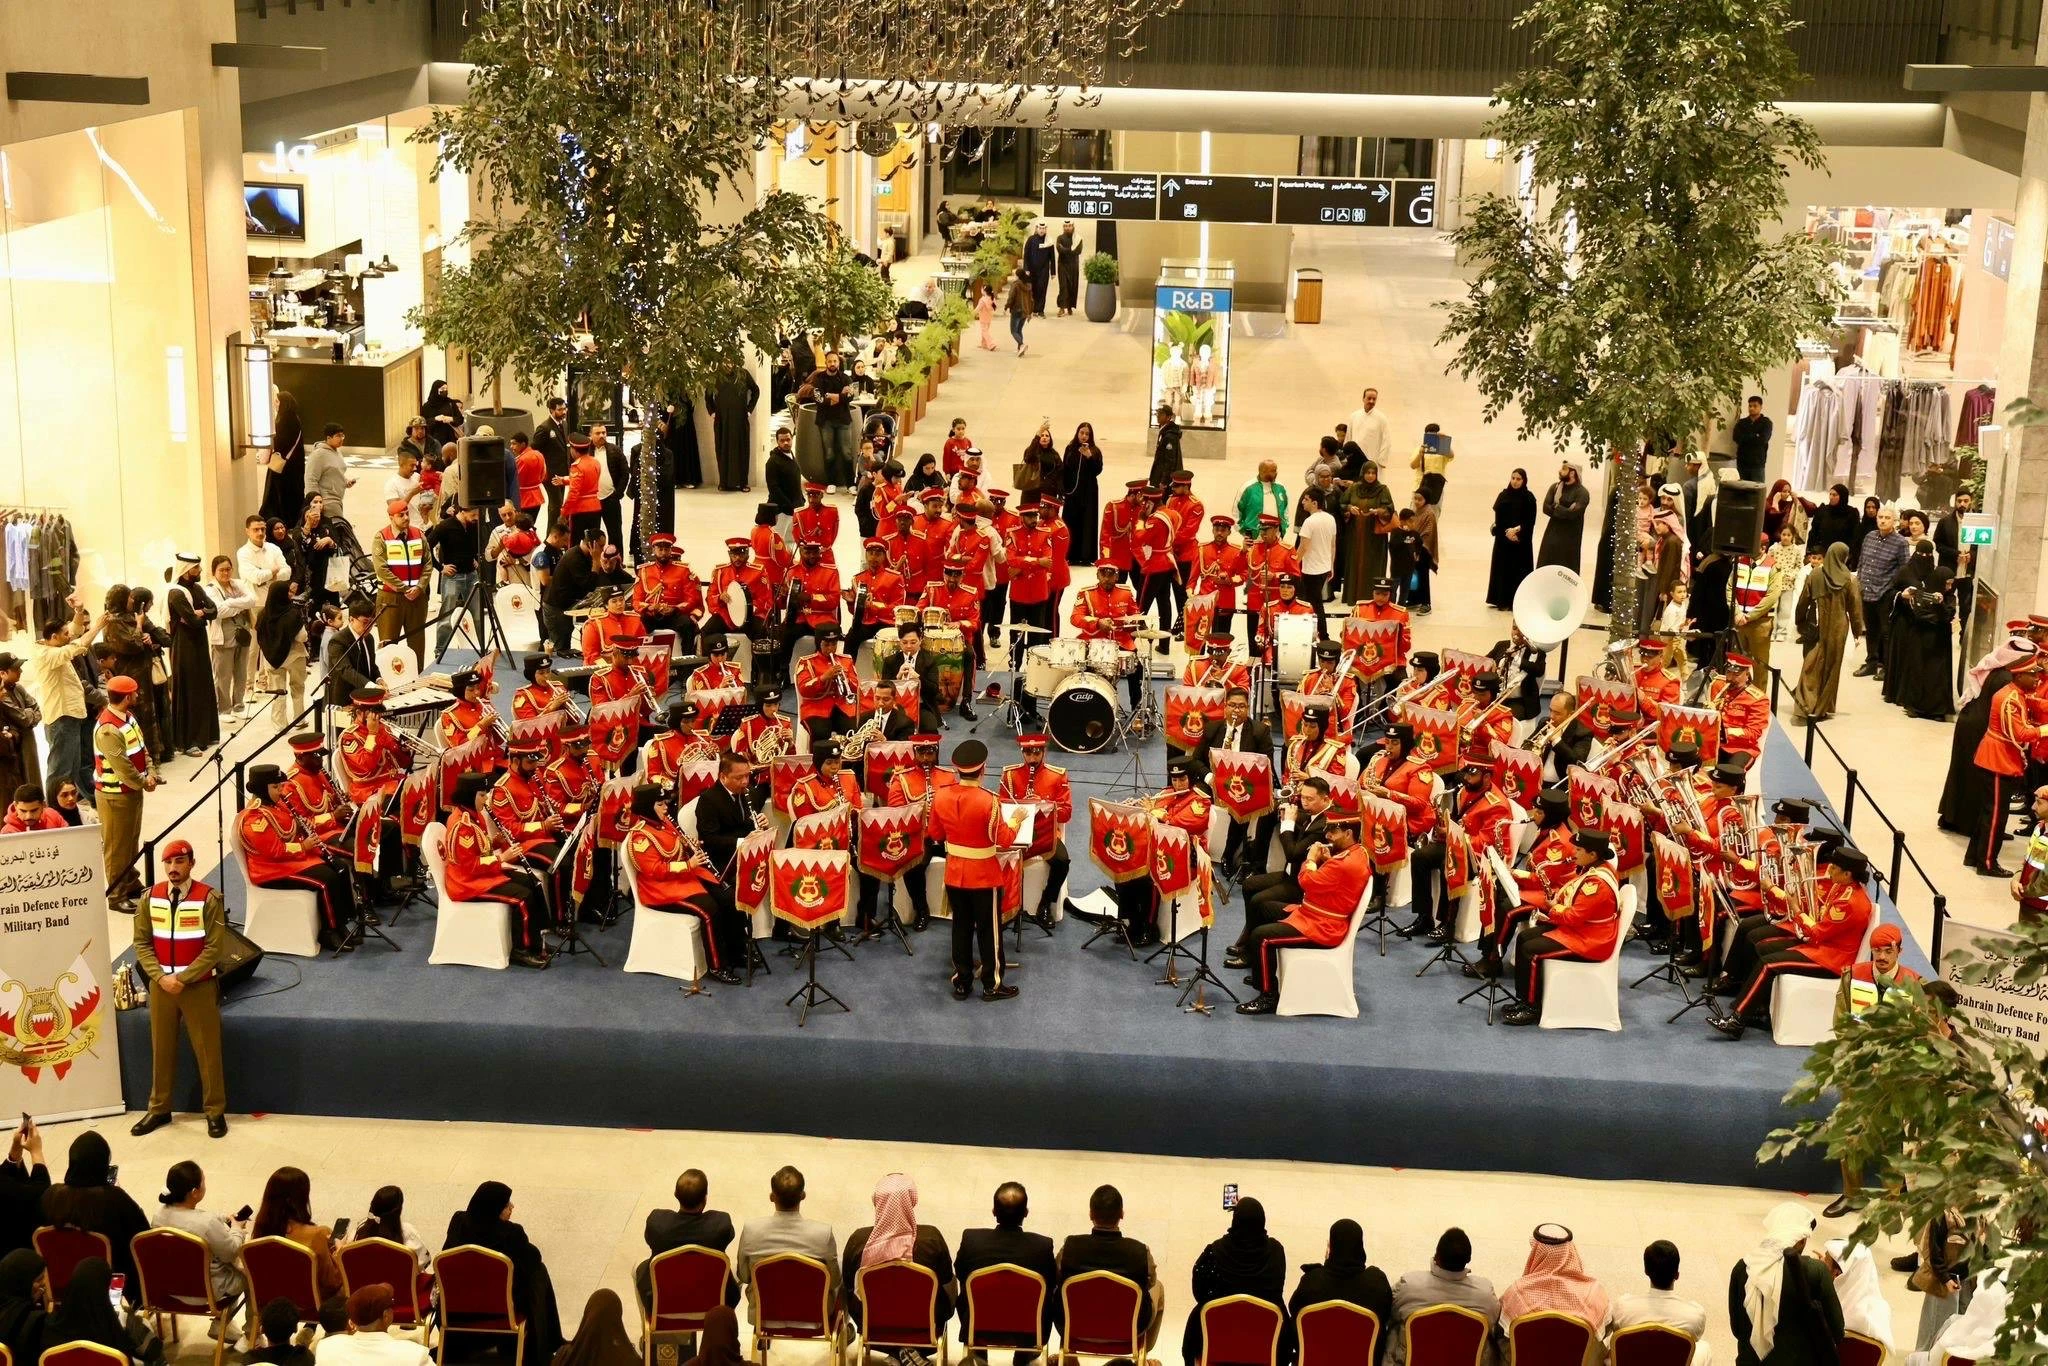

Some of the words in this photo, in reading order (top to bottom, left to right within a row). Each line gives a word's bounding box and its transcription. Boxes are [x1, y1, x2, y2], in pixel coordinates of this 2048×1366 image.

[862, 131, 890, 141] PUL
[1087, 190, 1106, 198] Parking
[1100, 183, 1119, 191] Parking
[1408, 196, 1433, 224] G
[1172, 290, 1214, 310] R&B
[29, 847, 45, 864] دفاع
[0, 903, 20, 915] rain
[22, 900, 60, 913] Defence
[61, 896, 88, 908] Force
[4, 919, 43, 933] Military
[45, 915, 70, 928] Band
[1957, 994, 1994, 1012] Bahrain
[1996, 1003, 2034, 1022] Defence
[2015, 1026, 2040, 1042] Band
